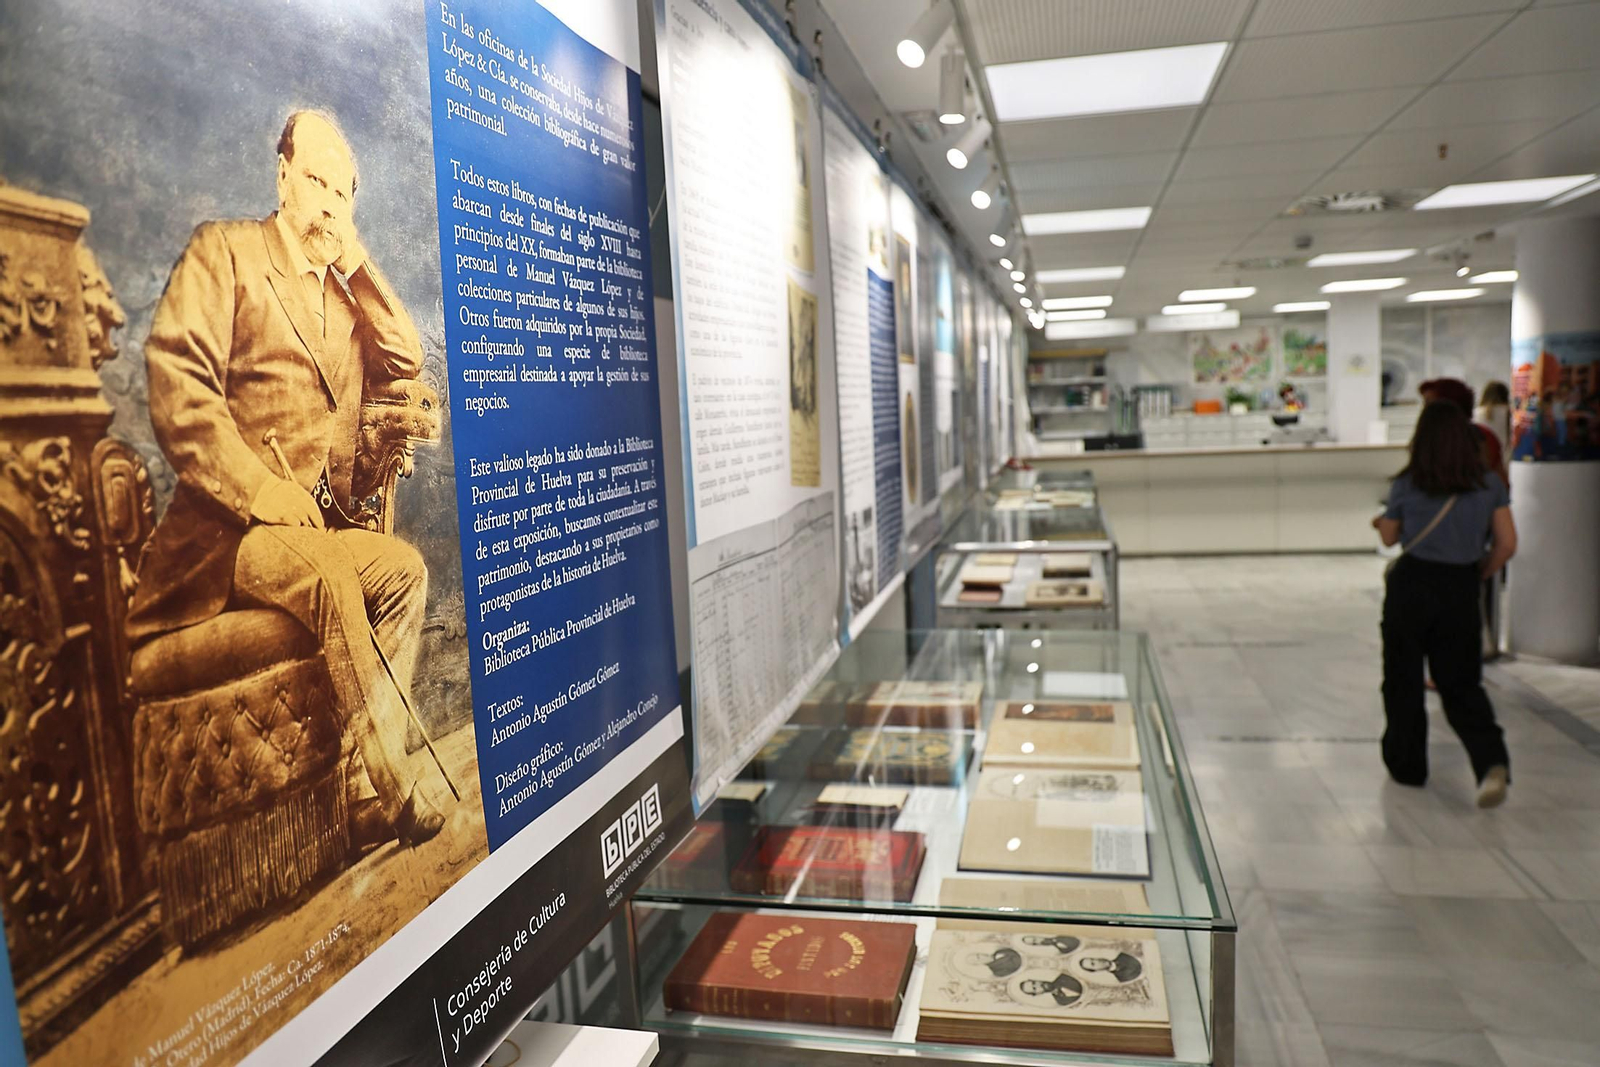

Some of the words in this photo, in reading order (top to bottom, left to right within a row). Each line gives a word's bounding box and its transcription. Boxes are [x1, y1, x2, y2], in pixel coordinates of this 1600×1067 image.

[440, 2, 456, 29] En
[461, 14, 474, 39] las
[479, 29, 514, 62] oficinas
[518, 50, 528, 70] de
[542, 63, 571, 97] Sociedad
[574, 85, 592, 110] Hijos
[595, 99, 604, 115] de
[442, 32, 476, 68] López
[477, 56, 487, 73] &
[489, 59, 508, 85] Cía.
[520, 81, 563, 117] conservaba,
[564, 105, 582, 126] desde
[583, 114, 599, 135] hace
[445, 67, 472, 96] años,
[478, 84, 497, 105] una
[502, 96, 540, 127] colección
[544, 113, 587, 151] bibliográfica
[591, 138, 599, 156] de
[447, 98, 508, 137] patrimonial.
[450, 158, 484, 189] Todos
[487, 175, 509, 197] estos
[512, 180, 537, 208] libros,
[538, 197, 553, 214] con
[554, 197, 576, 221] fechas
[578, 206, 587, 224] de
[589, 212, 628, 236] publicación
[629, 225, 640, 239] que
[453, 190, 492, 219] abarcan
[500, 204, 523, 228] desde
[531, 214, 554, 236] finales
[560, 224, 572, 243] del
[578, 229, 595, 251] siglo
[601, 234, 622, 255] XVIII
[454, 223, 503, 251] principios
[505, 232, 518, 253] del
[520, 235, 537, 260] XX,
[539, 240, 575, 267] formaban
[576, 255, 595, 272] parte
[597, 256, 606, 272] de
[456, 253, 497, 274] personal
[507, 258, 518, 278] de
[526, 262, 555, 286] Manuel
[562, 271, 595, 295] Vázquez
[601, 279, 622, 298] López
[457, 278, 512, 303] colecciones
[516, 290, 560, 310] particulares
[563, 294, 573, 312] de
[576, 295, 604, 318] algunos
[618, 307, 628, 318] sus
[459, 306, 489, 327] Otros
[493, 309, 523, 330] fueron
[526, 316, 566, 338] adquiridos
[569, 324, 583, 341] por
[595, 326, 617, 343] propia
[461, 335, 524, 362] configurando
[537, 346, 552, 357] una
[564, 344, 590, 363] especie
[602, 344, 610, 360] de
[463, 363, 517, 389] empresarial
[521, 364, 558, 382] destinada
[569, 370, 594, 387] apoyar
[607, 367, 629, 386] gestión
[465, 392, 509, 417] negocios.
[470, 458, 491, 477] Este
[494, 453, 523, 474] valioso
[526, 450, 552, 473] legado
[555, 447, 565, 464] ha
[568, 444, 583, 462] sido
[586, 441, 611, 459] donado
[626, 437, 653, 453] Biblioteca
[472, 477, 518, 505] Provincial
[525, 476, 535, 494] de
[542, 470, 572, 490] Huelva
[578, 470, 594, 489] para
[611, 458, 648, 481] preservación
[474, 510, 510, 533] disfrute
[513, 509, 528, 528] por
[531, 501, 553, 520] parte
[555, 495, 565, 513] de
[569, 492, 585, 509] toda
[596, 483, 632, 503] ciudadanía.
[634, 479, 640, 493] A
[475, 541, 488, 560] de
[493, 537, 510, 556] esta
[513, 522, 561, 552] exposición,
[564, 515, 601, 534] buscamos
[604, 499, 646, 522] contextualizar
[477, 557, 532, 595] patrimonio,
[536, 539, 582, 568] destacando
[593, 536, 603, 550] sus
[606, 522, 642, 546] propietarios
[644, 519, 659, 530] como
[480, 578, 539, 622] protagonistas
[542, 573, 552, 592] de
[563, 561, 591, 584] historia
[593, 555, 601, 572] de
[602, 548, 627, 569] Huelva.
[482, 621, 530, 651] Organiza:
[484, 639, 530, 676] Biblioteca
[531, 626, 564, 653] Pública
[566, 610, 603, 637] Provincial
[604, 602, 612, 618] de
[612, 593, 635, 615] Huelva
[487, 695, 523, 723] Textos:
[491, 713, 531, 748] Antonio
[533, 692, 567, 724] Agustín
[568, 676, 596, 701] Gómez
[596, 662, 620, 684] Gómez
[495, 761, 529, 795] Diseño
[531, 741, 563, 776] gráfico:
[499, 779, 538, 818] Antonio
[540, 755, 574, 789] Agustín
[574, 737, 601, 762] Gómez
[601, 732, 605, 750] y
[606, 709, 637, 740] Alejandro
[254, 971, 286, 1000] Fecha:
[287, 959, 303, 975] Ca.
[447, 946, 512, 1016] Consejería
[514, 931, 527, 952] de
[529, 892, 566, 934] Cultura
[147, 1021, 194, 1054] Manuel
[195, 988, 242, 1023] Vázquez
[243, 962, 276, 992] López.
[209, 1028, 238, 1054] Hijos
[239, 1014, 252, 1032] de
[252, 983, 294, 1019] Vázquez
[295, 961, 324, 986] López.
[451, 1025, 461, 1053] y
[464, 975, 513, 1036] Deporte
